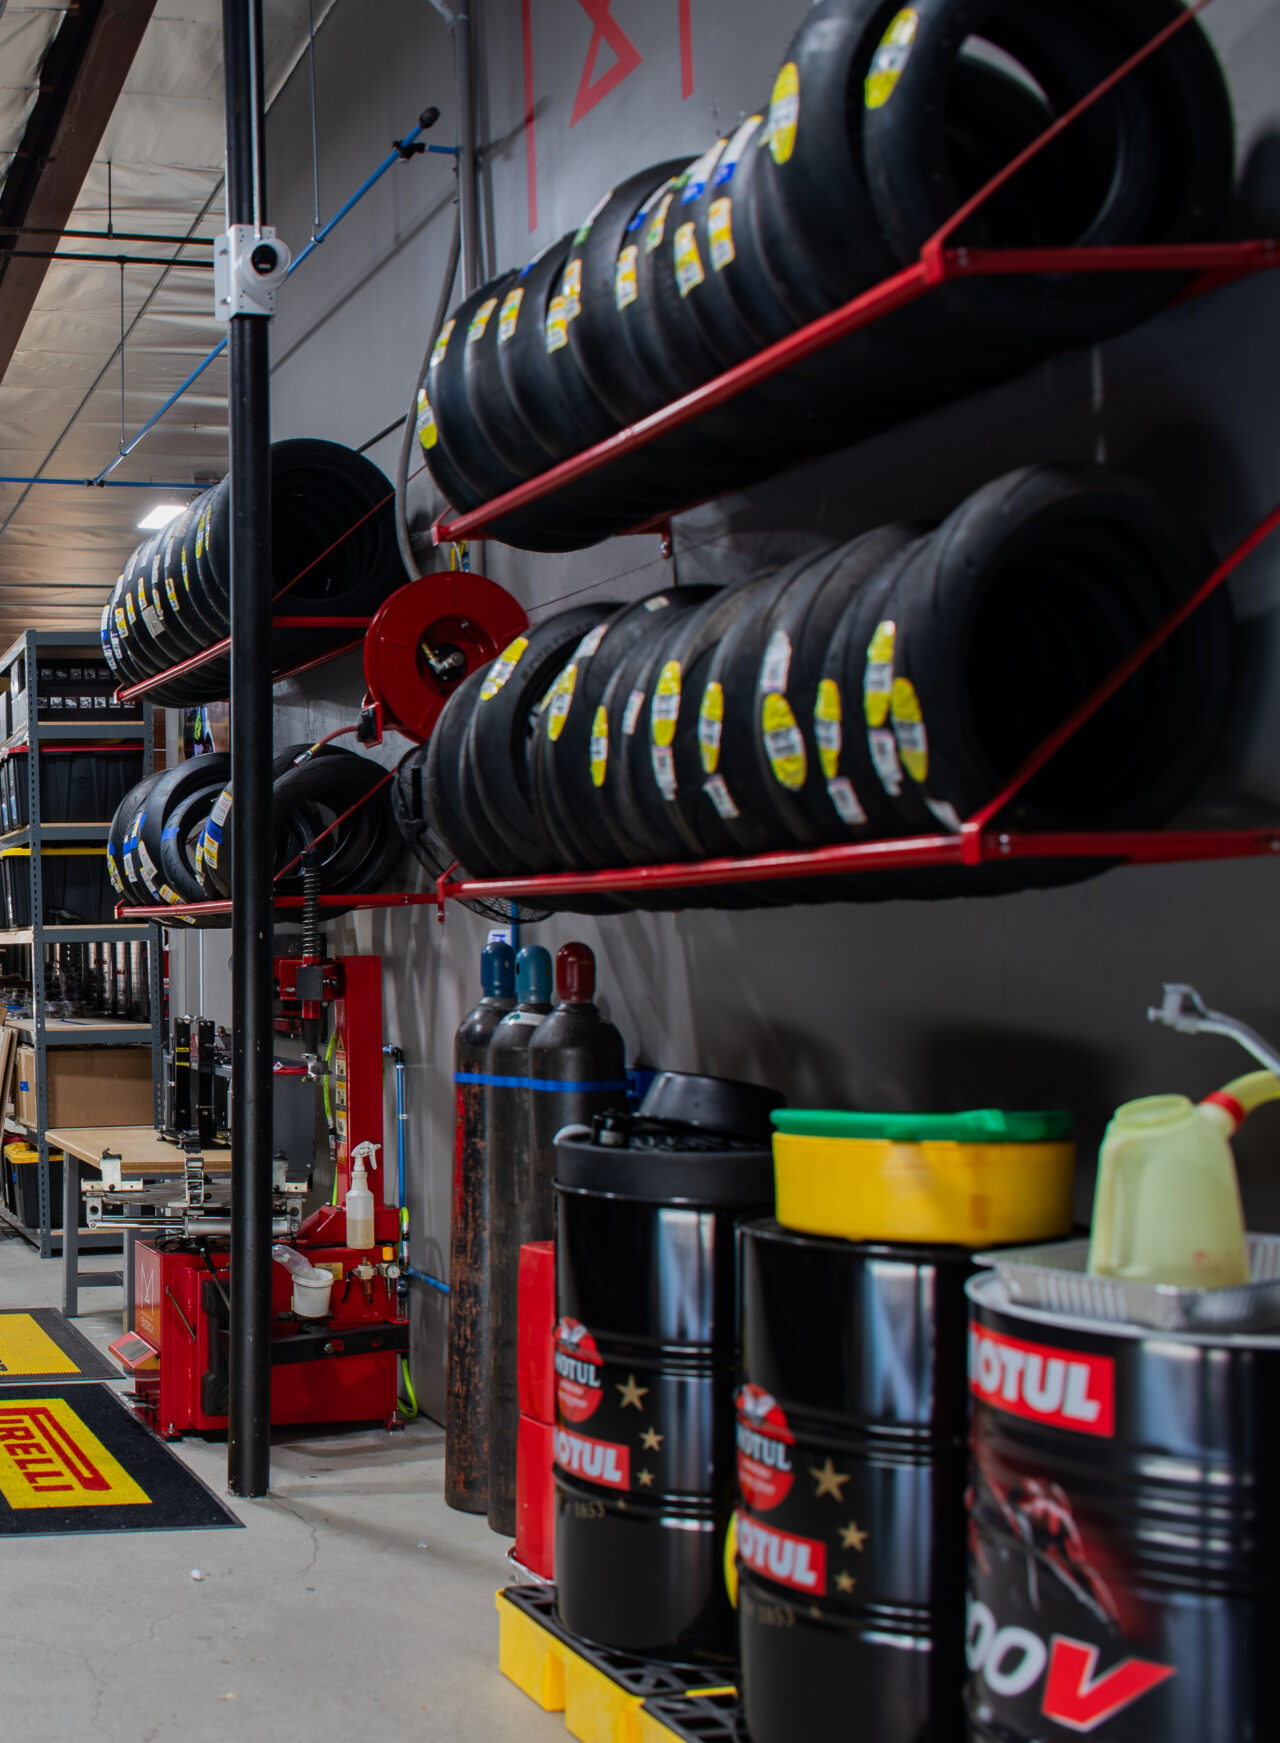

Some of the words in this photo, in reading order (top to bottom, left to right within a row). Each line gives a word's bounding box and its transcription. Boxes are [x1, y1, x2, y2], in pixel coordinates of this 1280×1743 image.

[555, 1427, 623, 1483] OTUL
[737, 1513, 819, 1588] OTUL
[966, 1600, 1177, 1733] 00V
